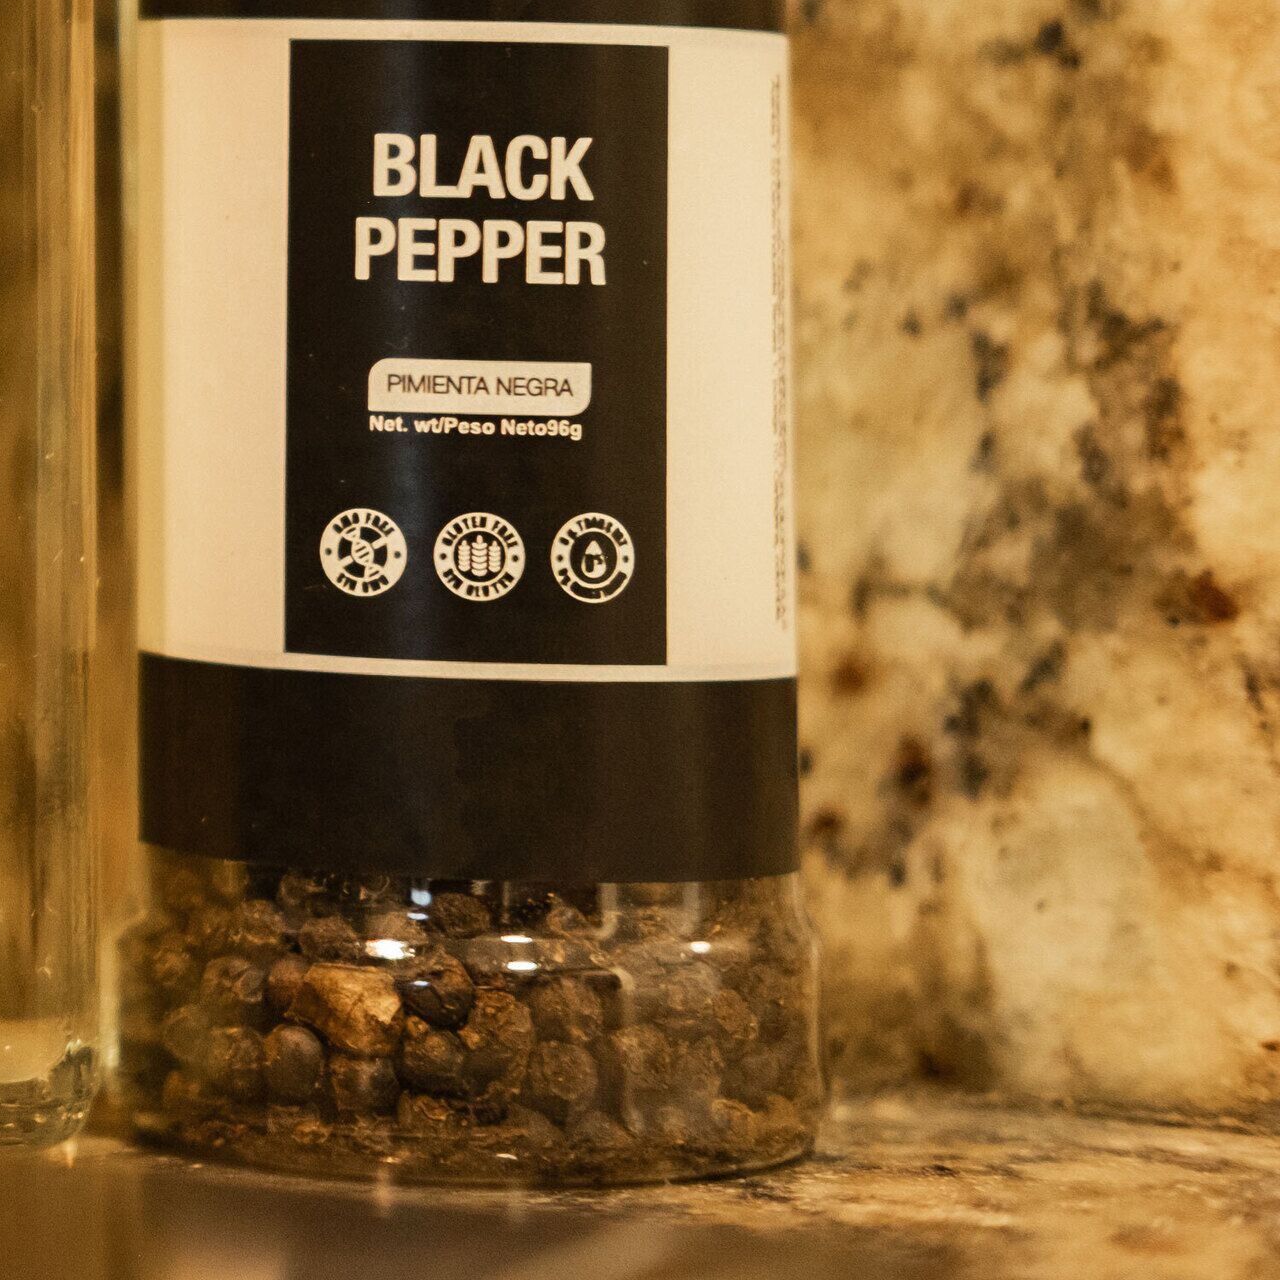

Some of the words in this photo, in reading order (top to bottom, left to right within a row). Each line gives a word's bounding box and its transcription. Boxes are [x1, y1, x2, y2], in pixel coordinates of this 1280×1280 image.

[372, 132, 595, 202] BLACK
[353, 216, 607, 286] PEPPER
[387, 373, 490, 396] PIMIENTA
[496, 376, 574, 398] NEGRA
[369, 415, 408, 433] Net.
[414, 416, 496, 436] wt/Peso
